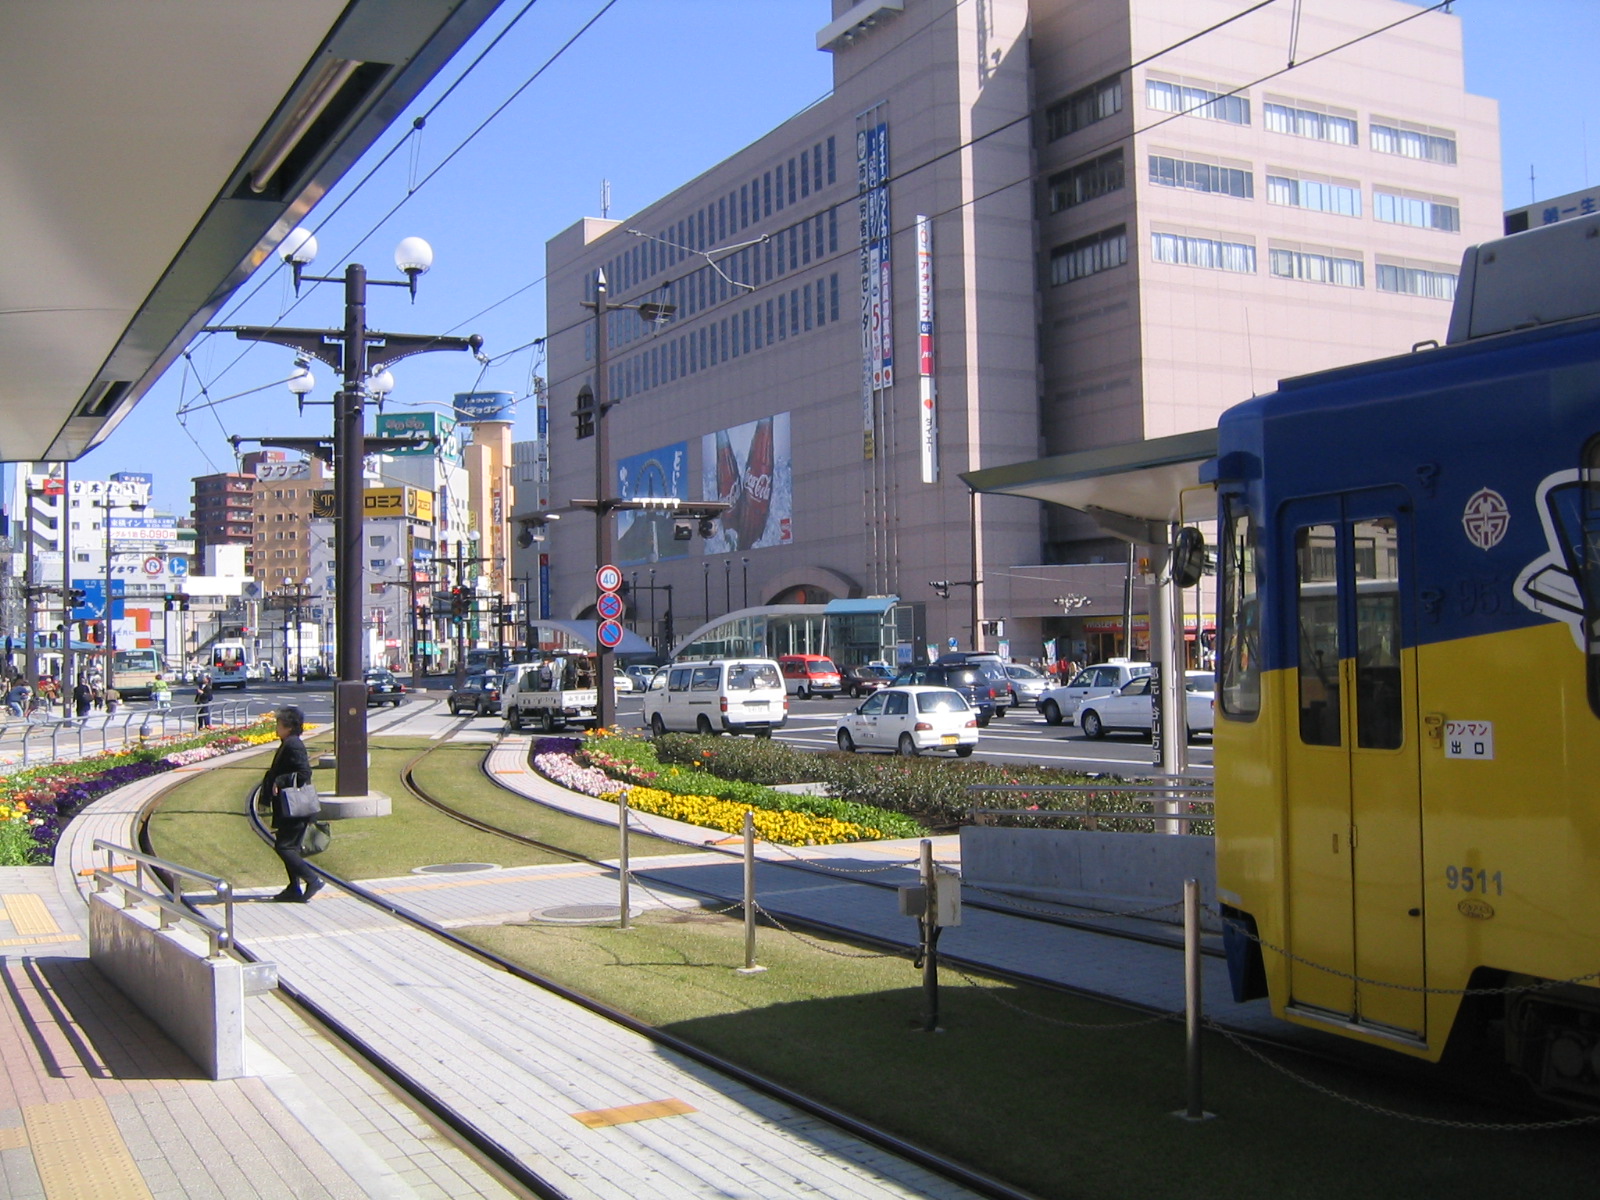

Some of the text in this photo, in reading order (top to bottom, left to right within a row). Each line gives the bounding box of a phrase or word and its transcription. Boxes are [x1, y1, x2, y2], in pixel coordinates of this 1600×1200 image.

[921, 323, 931, 333] 6F
[925, 418, 933, 453] ダイエー
[262, 464, 302, 478] サウナ
[365, 495, 402, 509] ロミス
[602, 573, 616, 585] 40
[1446, 723, 1488, 736] ワンマン
[1451, 740, 1485, 755] 出口
[1445, 865, 1503, 896] 9511
